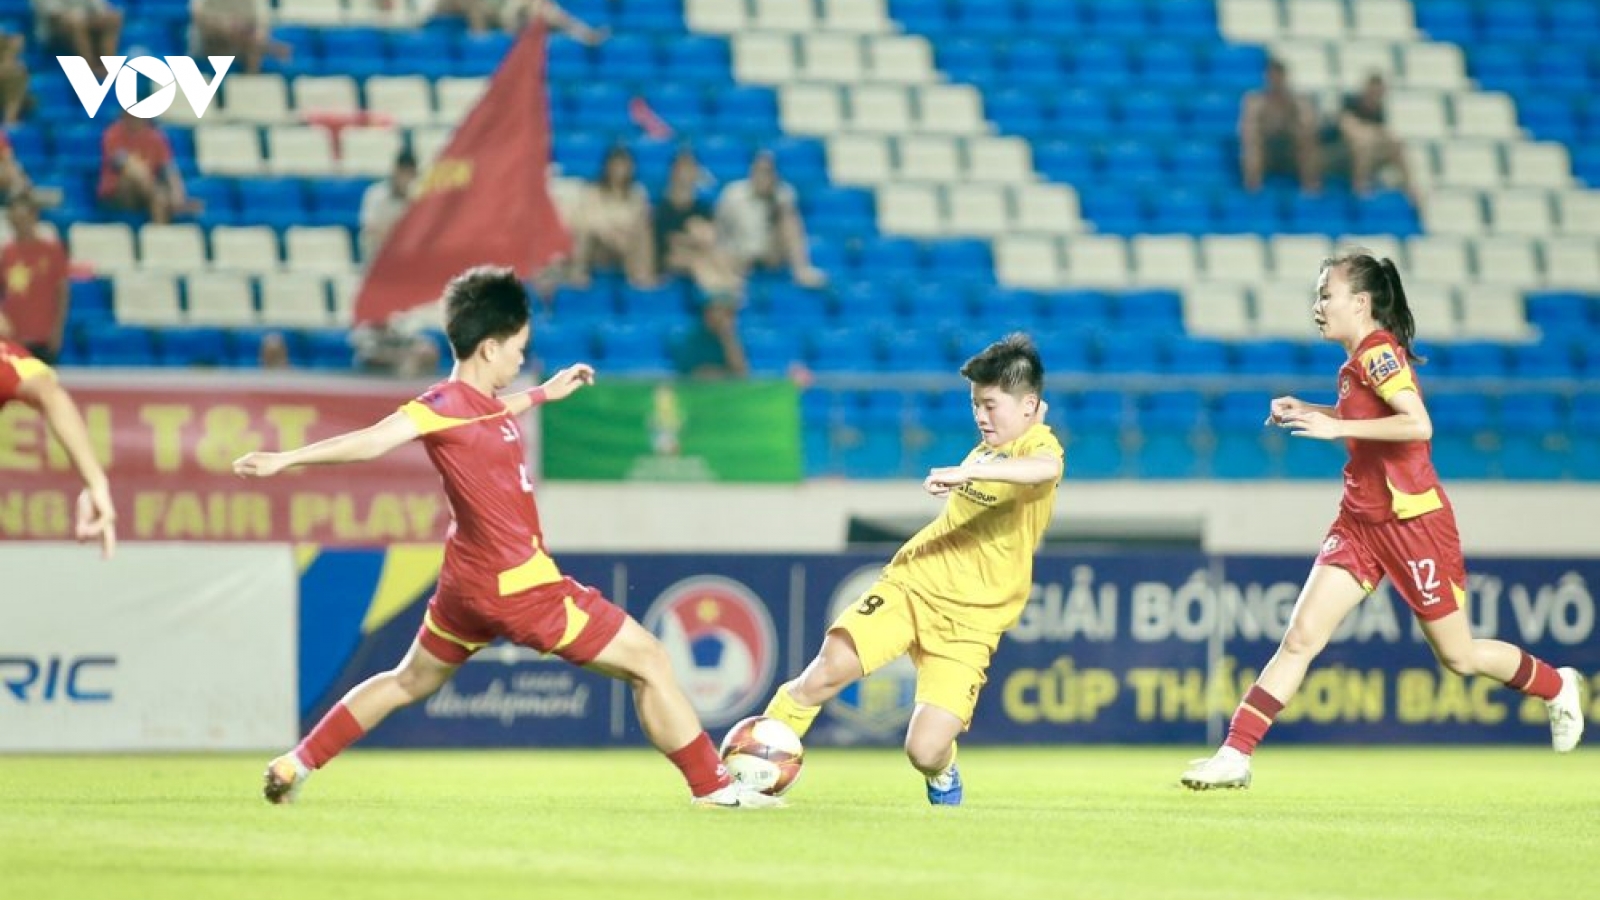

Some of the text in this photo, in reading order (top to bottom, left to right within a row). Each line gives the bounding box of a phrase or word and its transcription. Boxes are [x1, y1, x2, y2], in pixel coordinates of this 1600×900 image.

[1370, 360, 1398, 382] TSB
[140, 404, 319, 473] T&T
[134, 492, 270, 539] FAIR
[291, 492, 437, 539] PLAY
[1407, 558, 1440, 591] 12
[1132, 568, 1298, 642] BÓNG
[1509, 570, 1596, 645] VÔ
